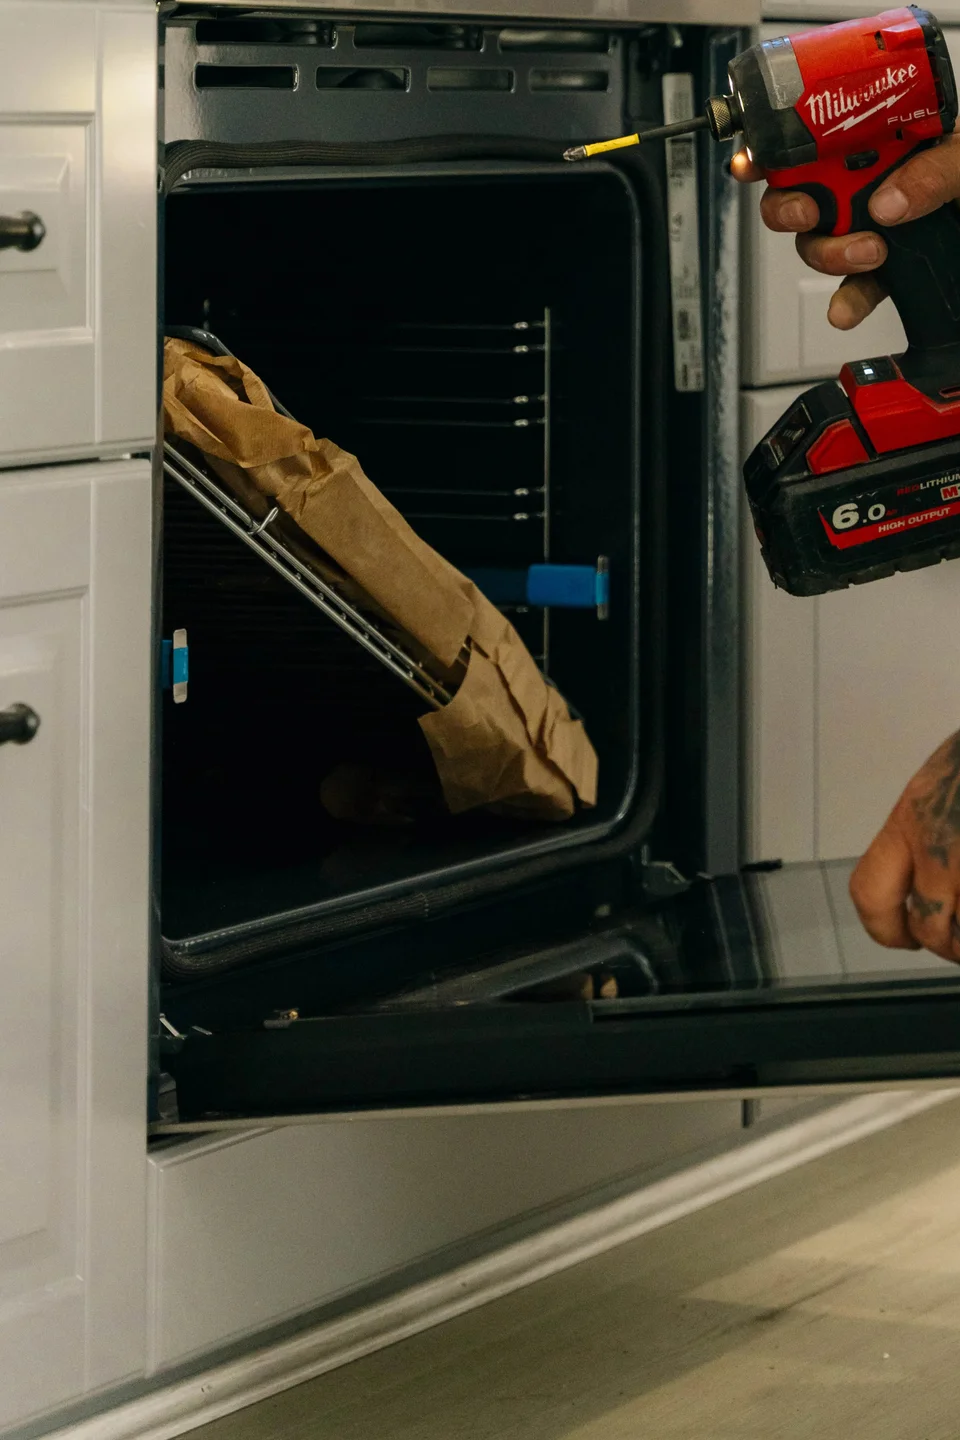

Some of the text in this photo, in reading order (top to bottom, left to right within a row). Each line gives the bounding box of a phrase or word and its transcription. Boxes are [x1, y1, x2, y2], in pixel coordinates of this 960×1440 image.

[887, 108, 937, 125] FUEL
[832, 503, 886, 530] 6.0
[878, 521, 905, 533] HIGH
[908, 507, 951, 525] OUTPUT
